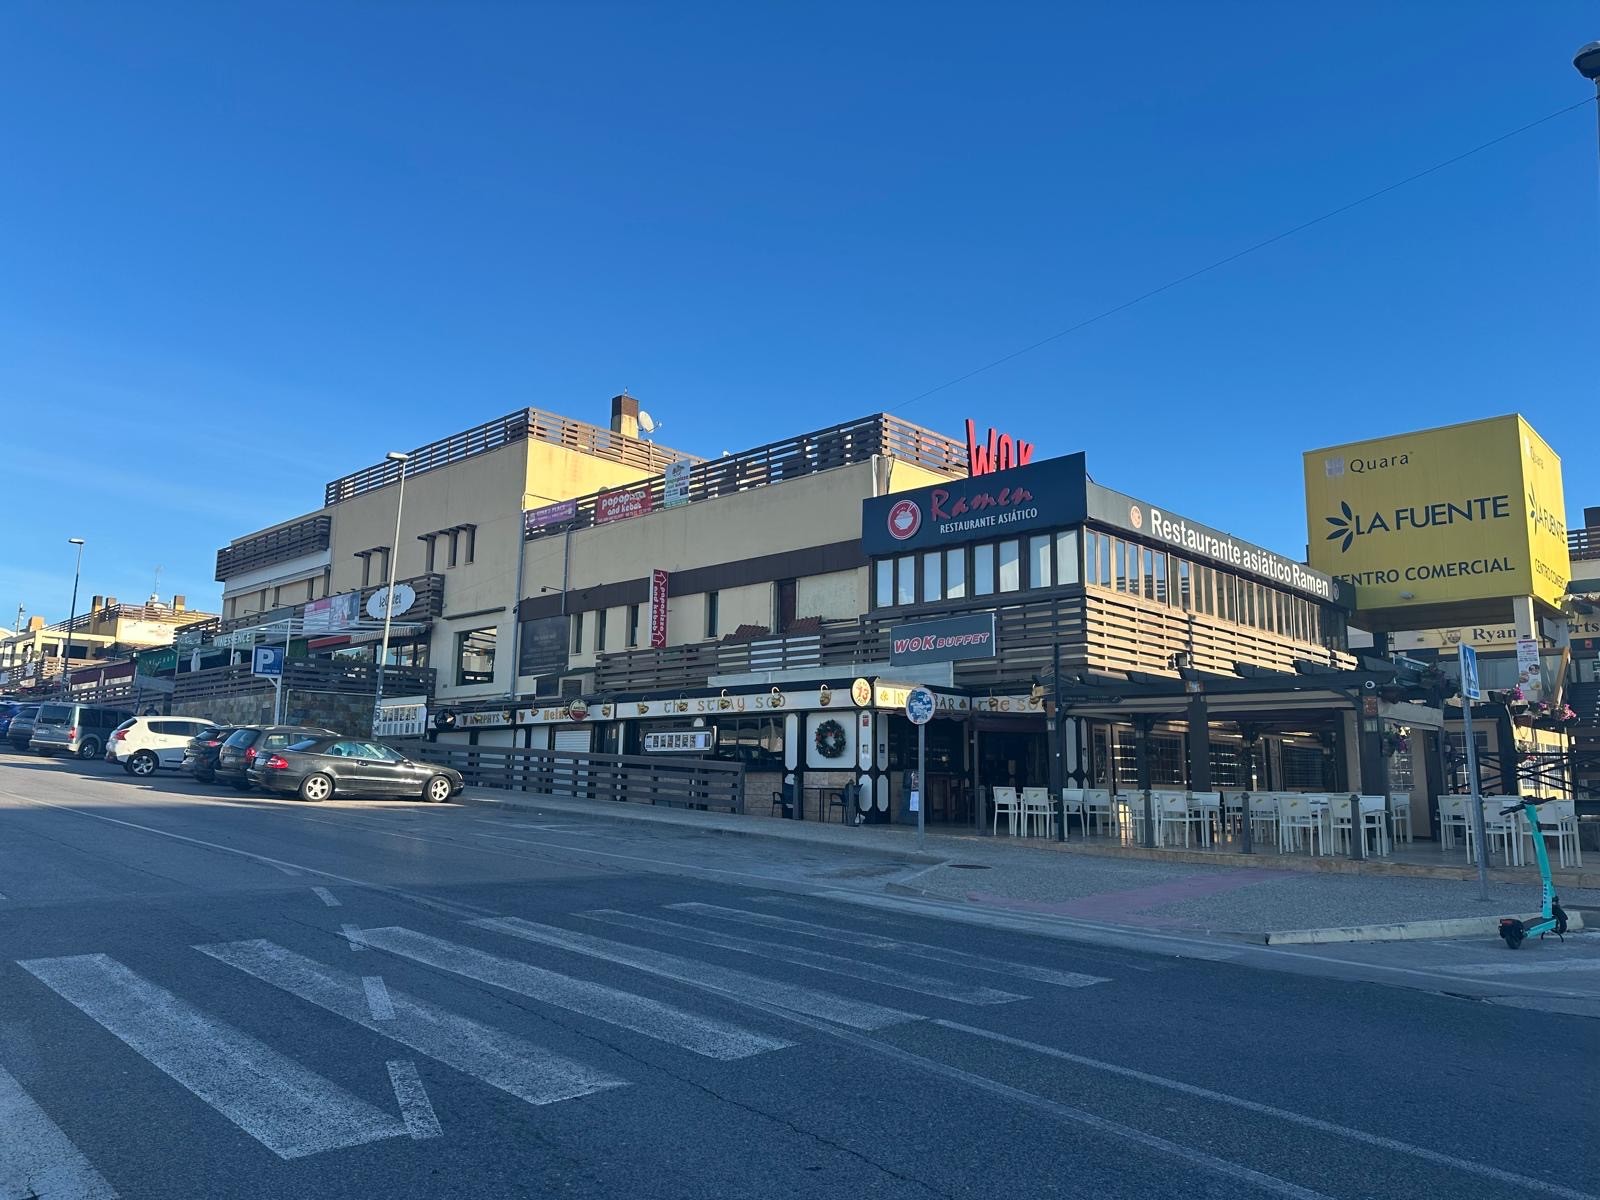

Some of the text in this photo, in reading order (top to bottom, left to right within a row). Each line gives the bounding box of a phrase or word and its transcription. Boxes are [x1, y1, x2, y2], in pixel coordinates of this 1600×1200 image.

[1350, 454, 1409, 473] Quara
[607, 505, 620, 516] and
[930, 487, 1033, 521] Ramen
[1356, 495, 1510, 535] LA FUENTE
[940, 508, 1038, 534] RESTAURANTE ASIÁTICO
[1151, 508, 1329, 597] Restaurante asiático Ramen
[1405, 557, 1515, 581] COMERCIAL
[894, 632, 990, 653] WOK BUFFET
[256, 648, 275, 672] P
[664, 699, 688, 713] th
